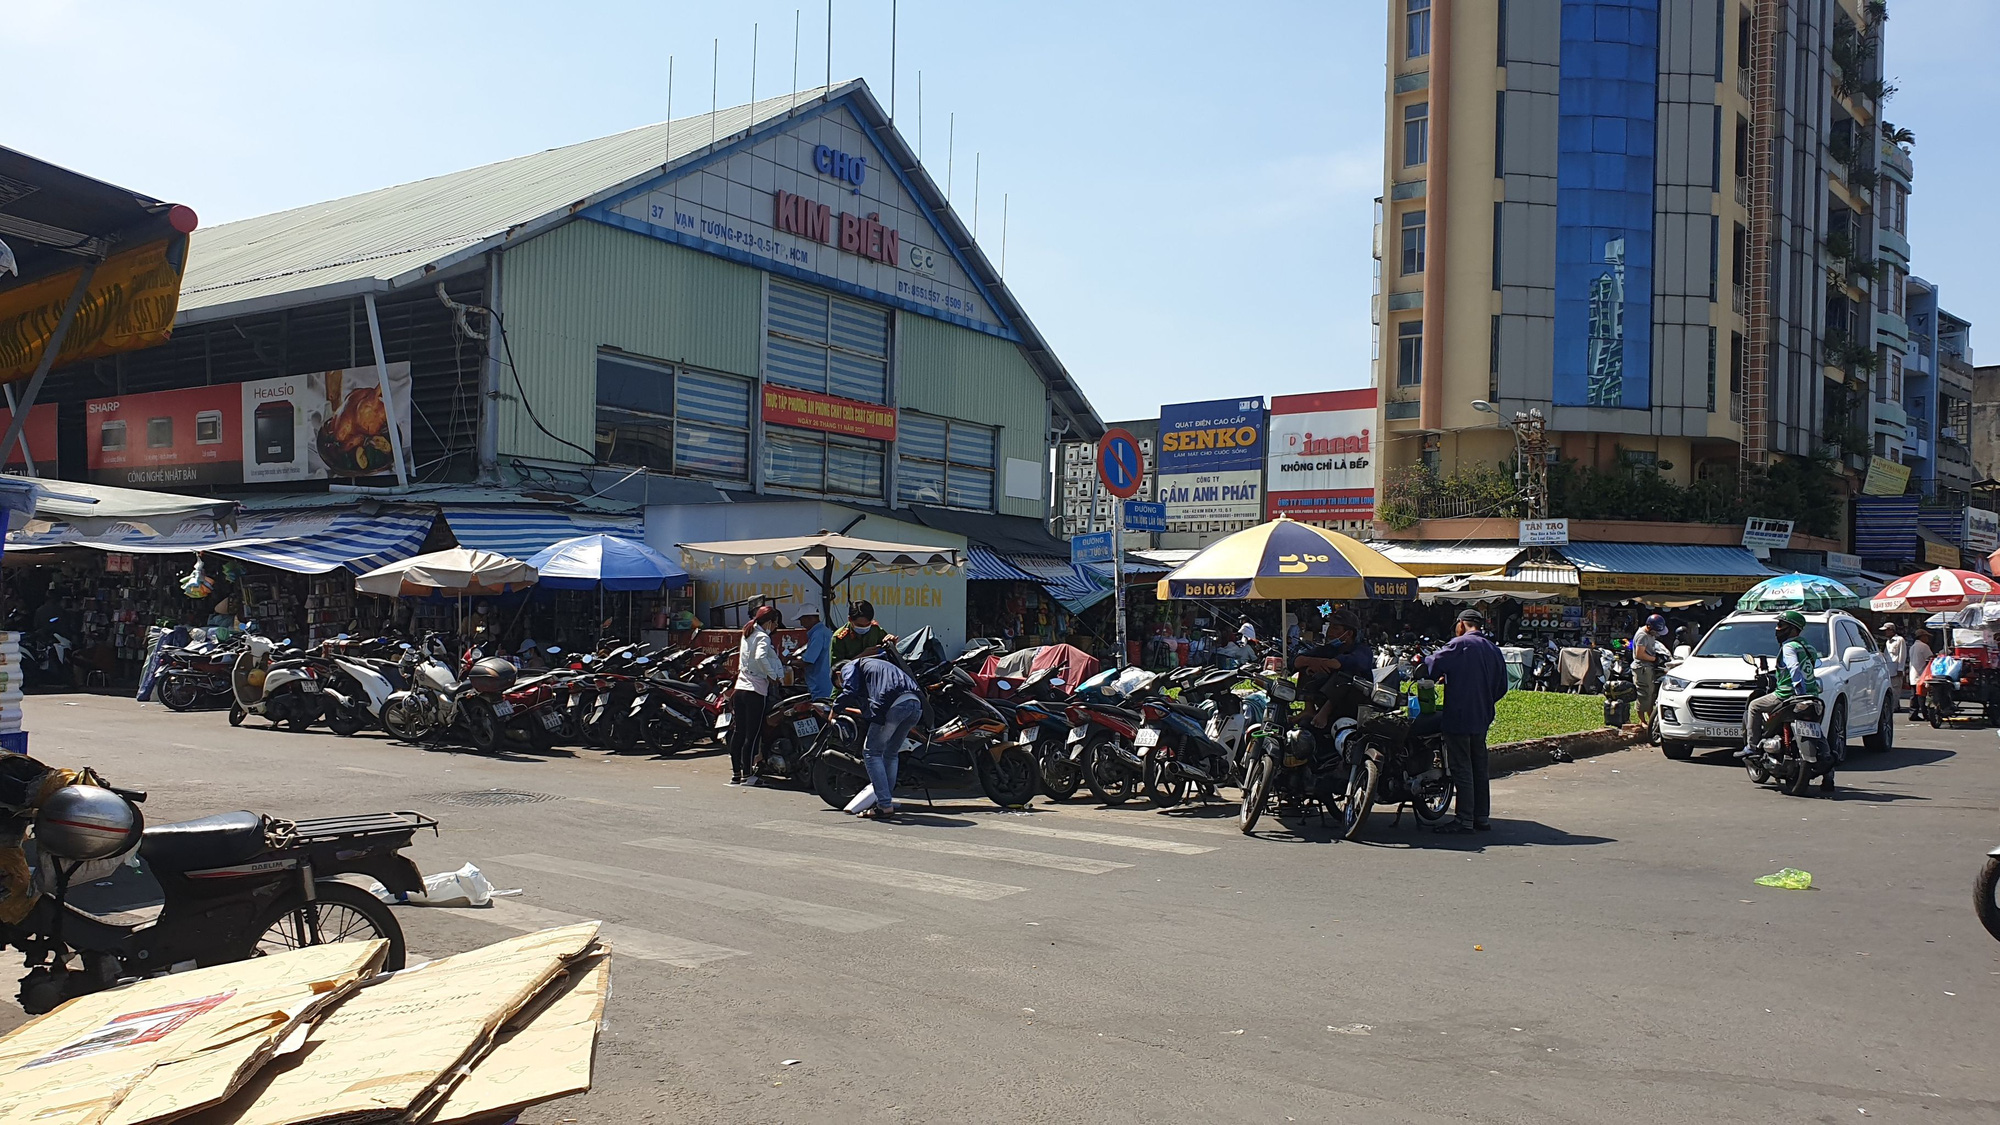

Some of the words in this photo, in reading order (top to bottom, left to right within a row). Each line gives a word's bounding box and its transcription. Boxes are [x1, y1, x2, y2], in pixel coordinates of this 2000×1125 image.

[813, 144, 867, 196] CHỢ
[651, 205, 664, 219] 37
[675, 211, 695, 229] VẠN
[790, 247, 808, 264] HCM
[776, 189, 831, 244] KIM
[839, 211, 899, 266] BIÊN
[88, 401, 120, 413] SHARP
[1174, 420, 1193, 429] QUẠT
[1230, 415, 1246, 424] CẤP
[1162, 426, 1257, 452] SENKO
[1280, 461, 1314, 472] KHÔNG
[1316, 458, 1333, 471] CHỈ
[1334, 459, 1347, 470] LÀ
[1349, 457, 1369, 469] BẾP
[127, 470, 146, 483] CÔNG
[146, 469, 164, 484] NGHỆ
[165, 468, 182, 483] NHẬT
[1196, 476, 1211, 484] CÔNG
[1160, 481, 1189, 503] CẨM
[1192, 486, 1218, 502] ANH
[1222, 480, 1257, 501] PHÁT
[1134, 505, 1157, 513] ĐƯỜNG
[1082, 536, 1104, 546] ĐƯỜNG
[1303, 553, 1328, 563] be
[870, 585, 901, 606] KIM
[904, 583, 943, 607] BIÊN
[1185, 583, 1200, 596] be
[1203, 582, 1216, 596] là
[1218, 582, 1236, 596] tới
[1374, 582, 1385, 595] be
[1386, 582, 1396, 595] là
[252, 861, 283, 870] DAELIM
